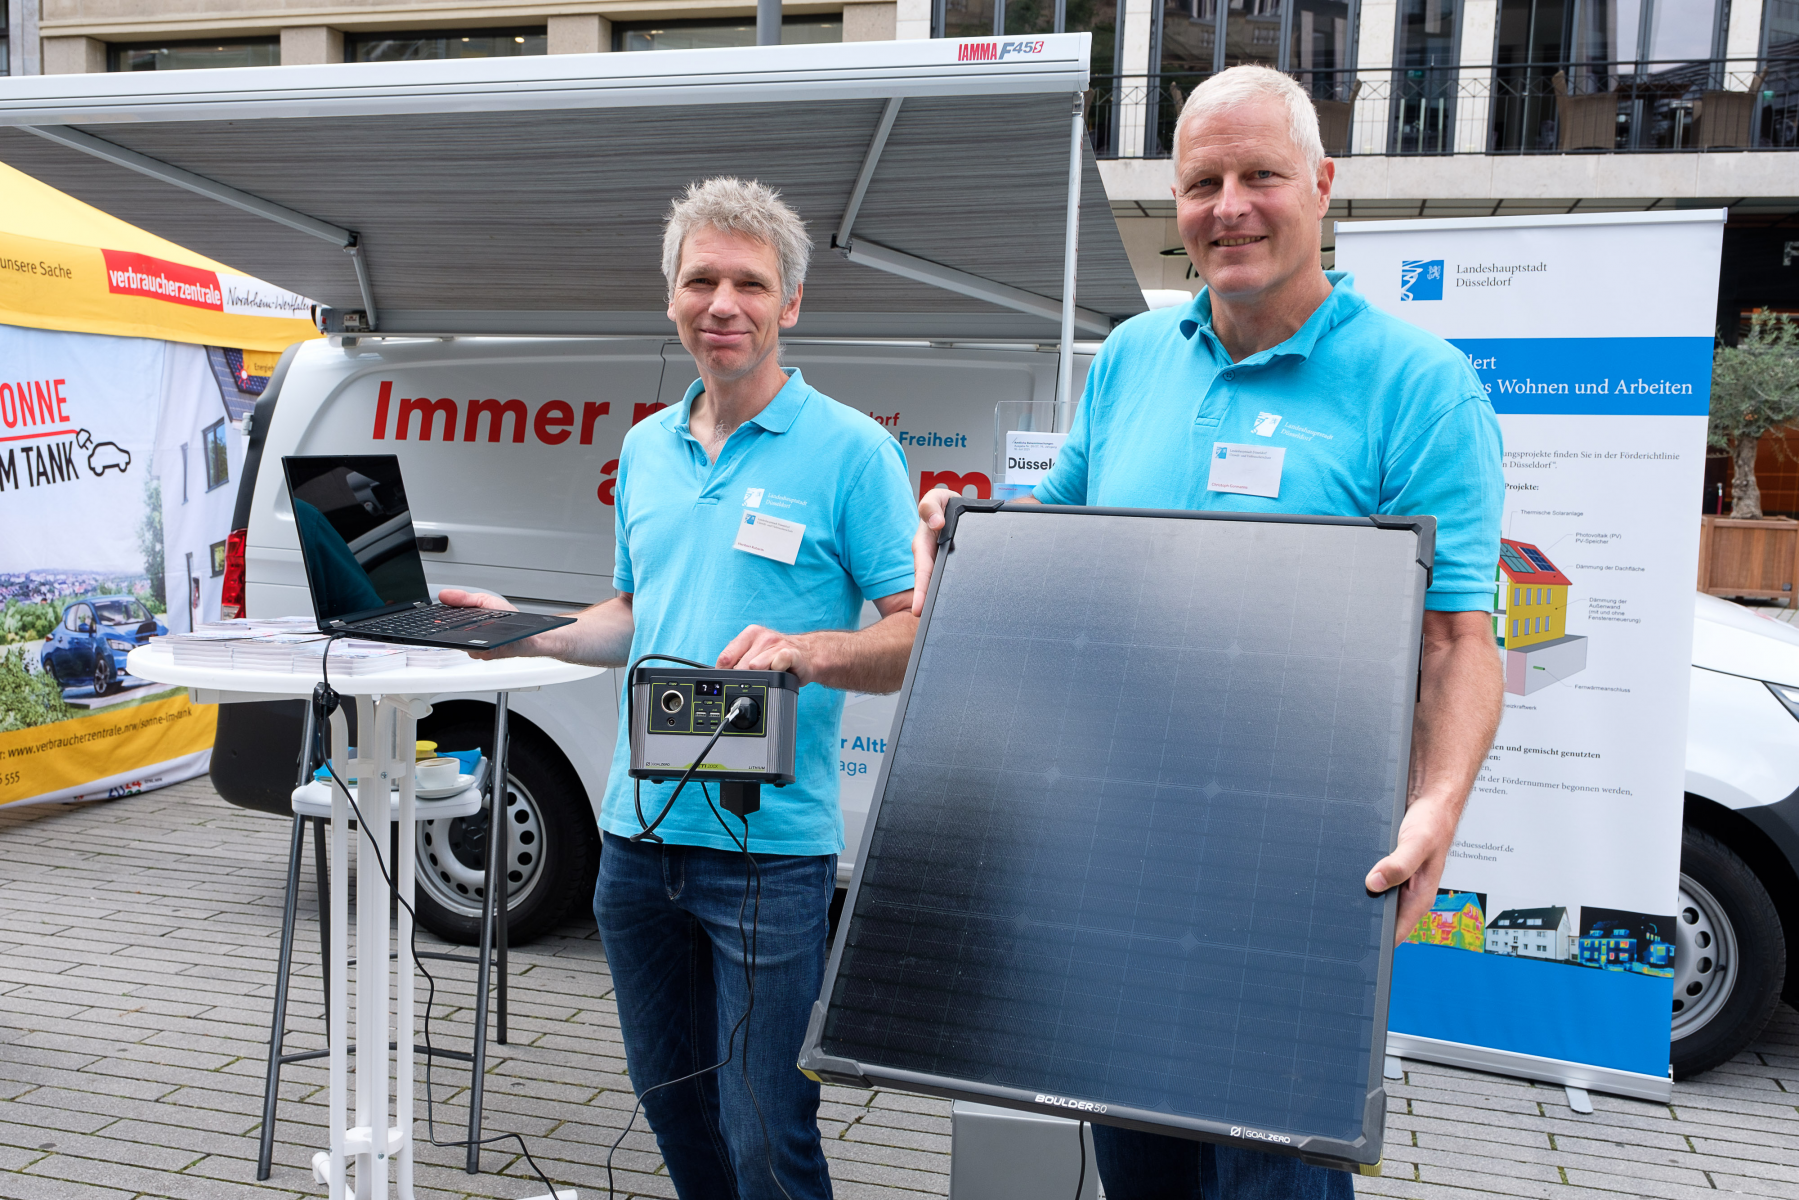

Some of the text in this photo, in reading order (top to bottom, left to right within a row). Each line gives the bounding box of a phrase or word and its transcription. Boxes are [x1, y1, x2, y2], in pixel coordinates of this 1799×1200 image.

[0, 257, 73, 280] unsere Sache
[1456, 262, 1548, 275] Landeshauptstadt
[109, 267, 222, 306] verbraucherzentrale
[1456, 276, 1512, 288] Düsseldorf
[1497, 378, 1569, 395] Wohnen
[1575, 378, 1609, 395] und
[1614, 378, 1693, 395] Arbeiten
[372, 380, 611, 446] Immer
[899, 431, 968, 449] Freiheit
[1553, 450, 1578, 459] finden
[1580, 451, 1592, 459] Sie
[1594, 451, 1602, 459] in
[1604, 451, 1617, 459] der
[1620, 450, 1680, 461] Förderichtlinie
[21, 440, 80, 488] TANK
[1008, 456, 1056, 471] Düssel
[1504, 482, 1540, 493] Projekte:
[1575, 563, 1603, 571] Dämmung
[1615, 564, 1646, 572] Dachfläche
[1589, 597, 1617, 605] Dämmung
[8, 708, 192, 757] www.verbraucherzentrale.nrw/sonne-im-tank
[1523, 747, 1559, 757] gemischt
[1560, 750, 1601, 760] genutzten
[4, 770, 21, 786] 555
[1478, 787, 1508, 796] werden.
[1487, 775, 1500, 783] der
[1502, 776, 1559, 788] Fördernummer
[1561, 782, 1600, 794] begonnen
[1601, 786, 1633, 797] werden,
